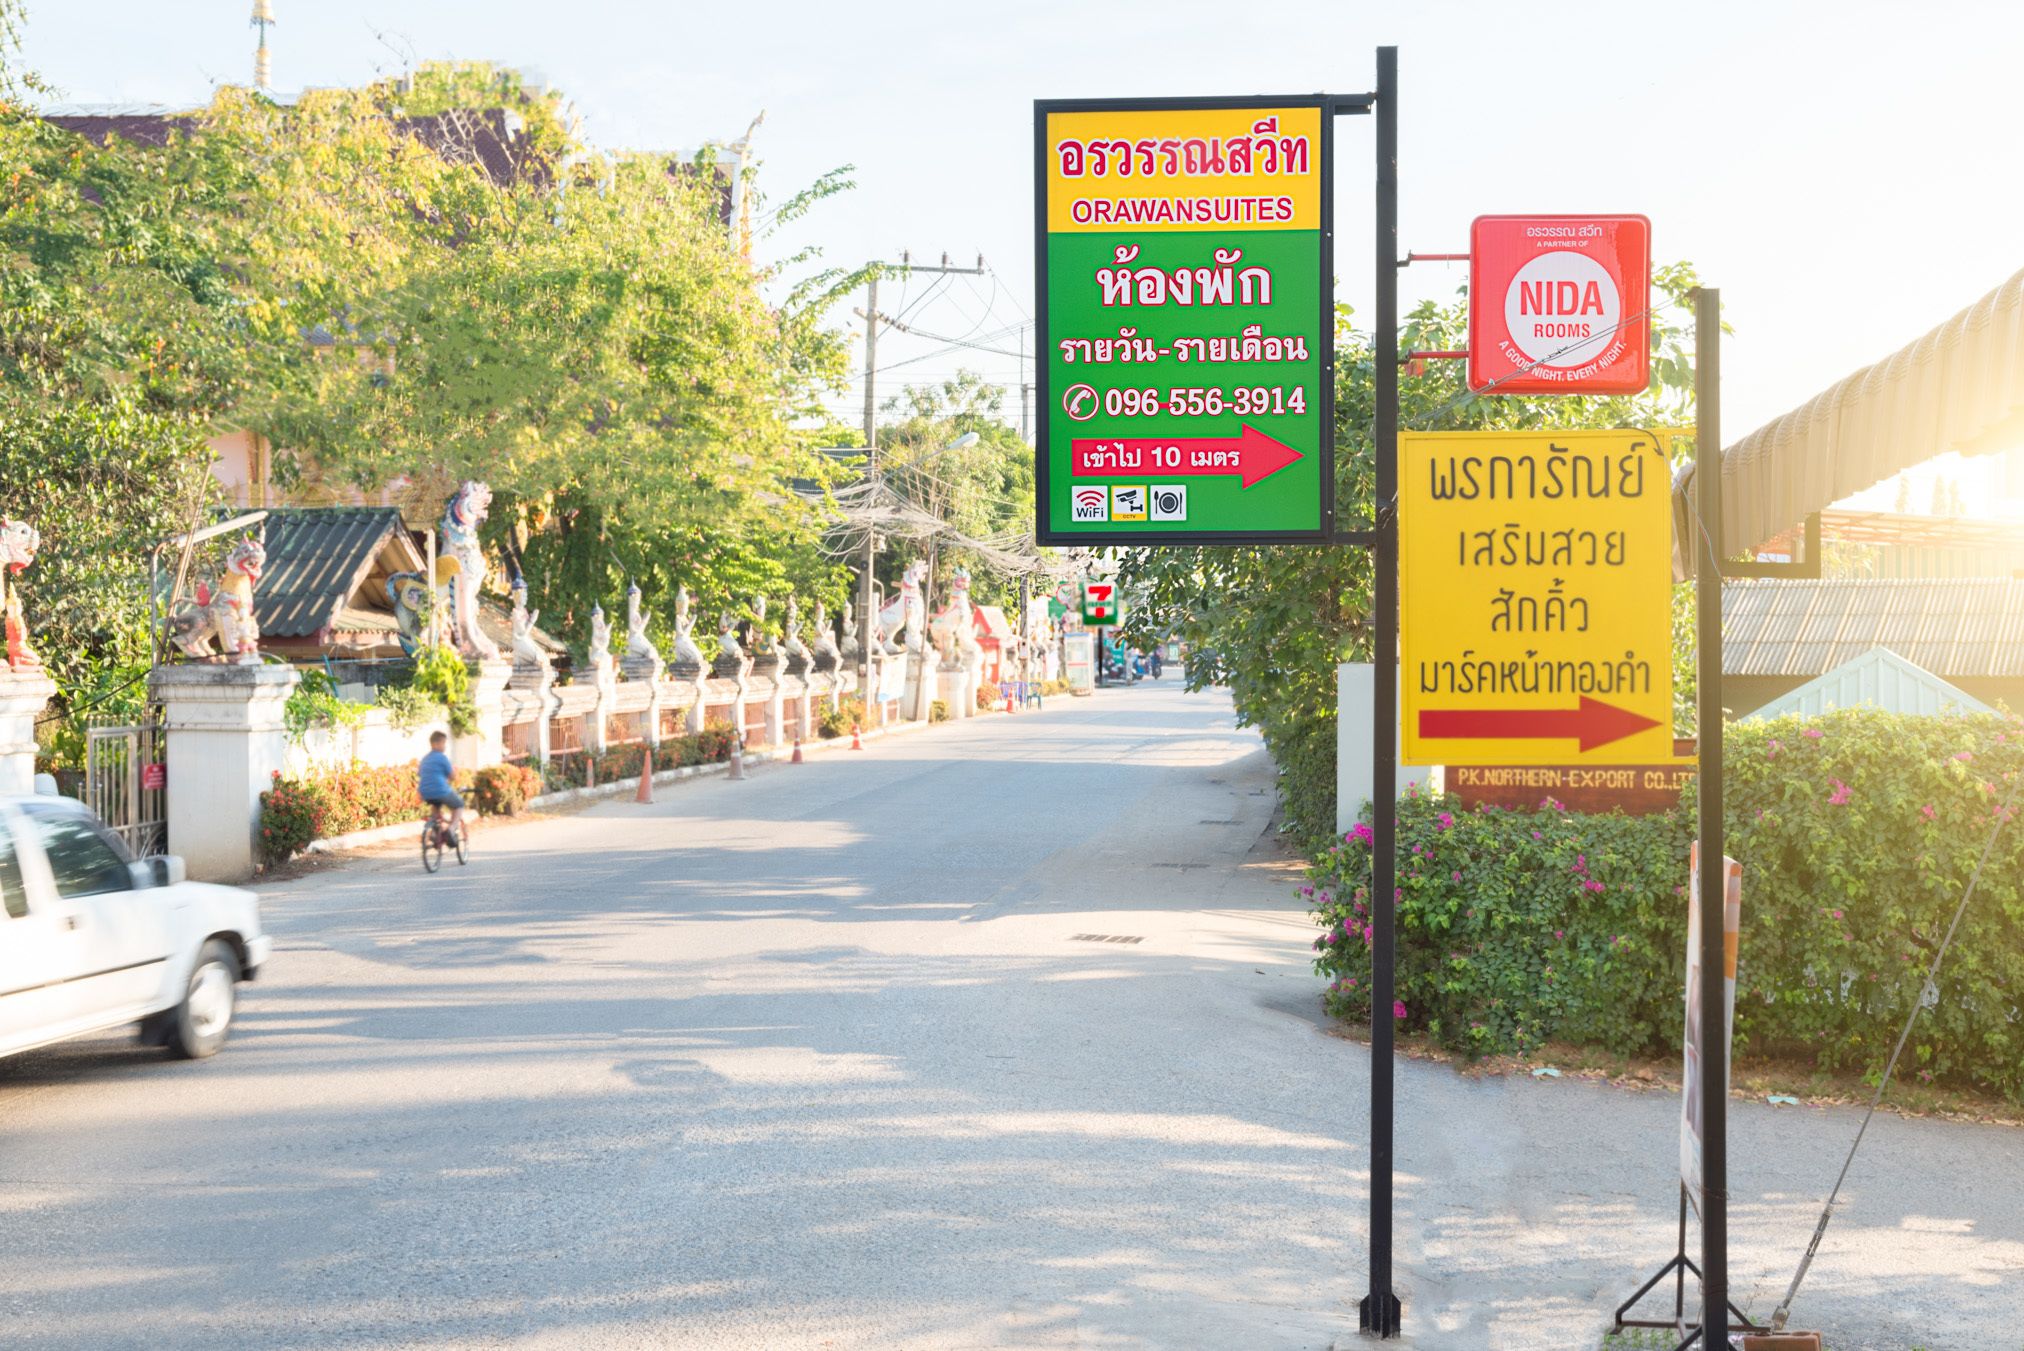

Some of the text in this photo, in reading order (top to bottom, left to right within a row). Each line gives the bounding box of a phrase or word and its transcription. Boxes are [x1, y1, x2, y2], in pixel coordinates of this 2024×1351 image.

[1057, 117, 1309, 176] อรวรรณสวีท
[1072, 197, 1293, 223] ORAWANSUITES
[1543, 240, 1576, 248] PARTNER
[1096, 244, 1272, 307] ห้องพัก
[1520, 281, 1604, 316] NIDA
[1534, 323, 1591, 338] ROOMS
[1499, 340, 1627, 382] A GOOD NIGHT. EVERY NIGHT.
[1105, 386, 1306, 416] 096-556-3914
[1083, 442, 1240, 468] เข้าไป 10 เมตร
[1076, 506, 1104, 518] WiFi
[1459, 523, 1625, 566] เสริมสวย
[1088, 585, 1111, 618] 7
[1491, 578, 1588, 632] สักคิ้ว
[1420, 649, 1651, 694] มาร์คหน้าทองคำ
